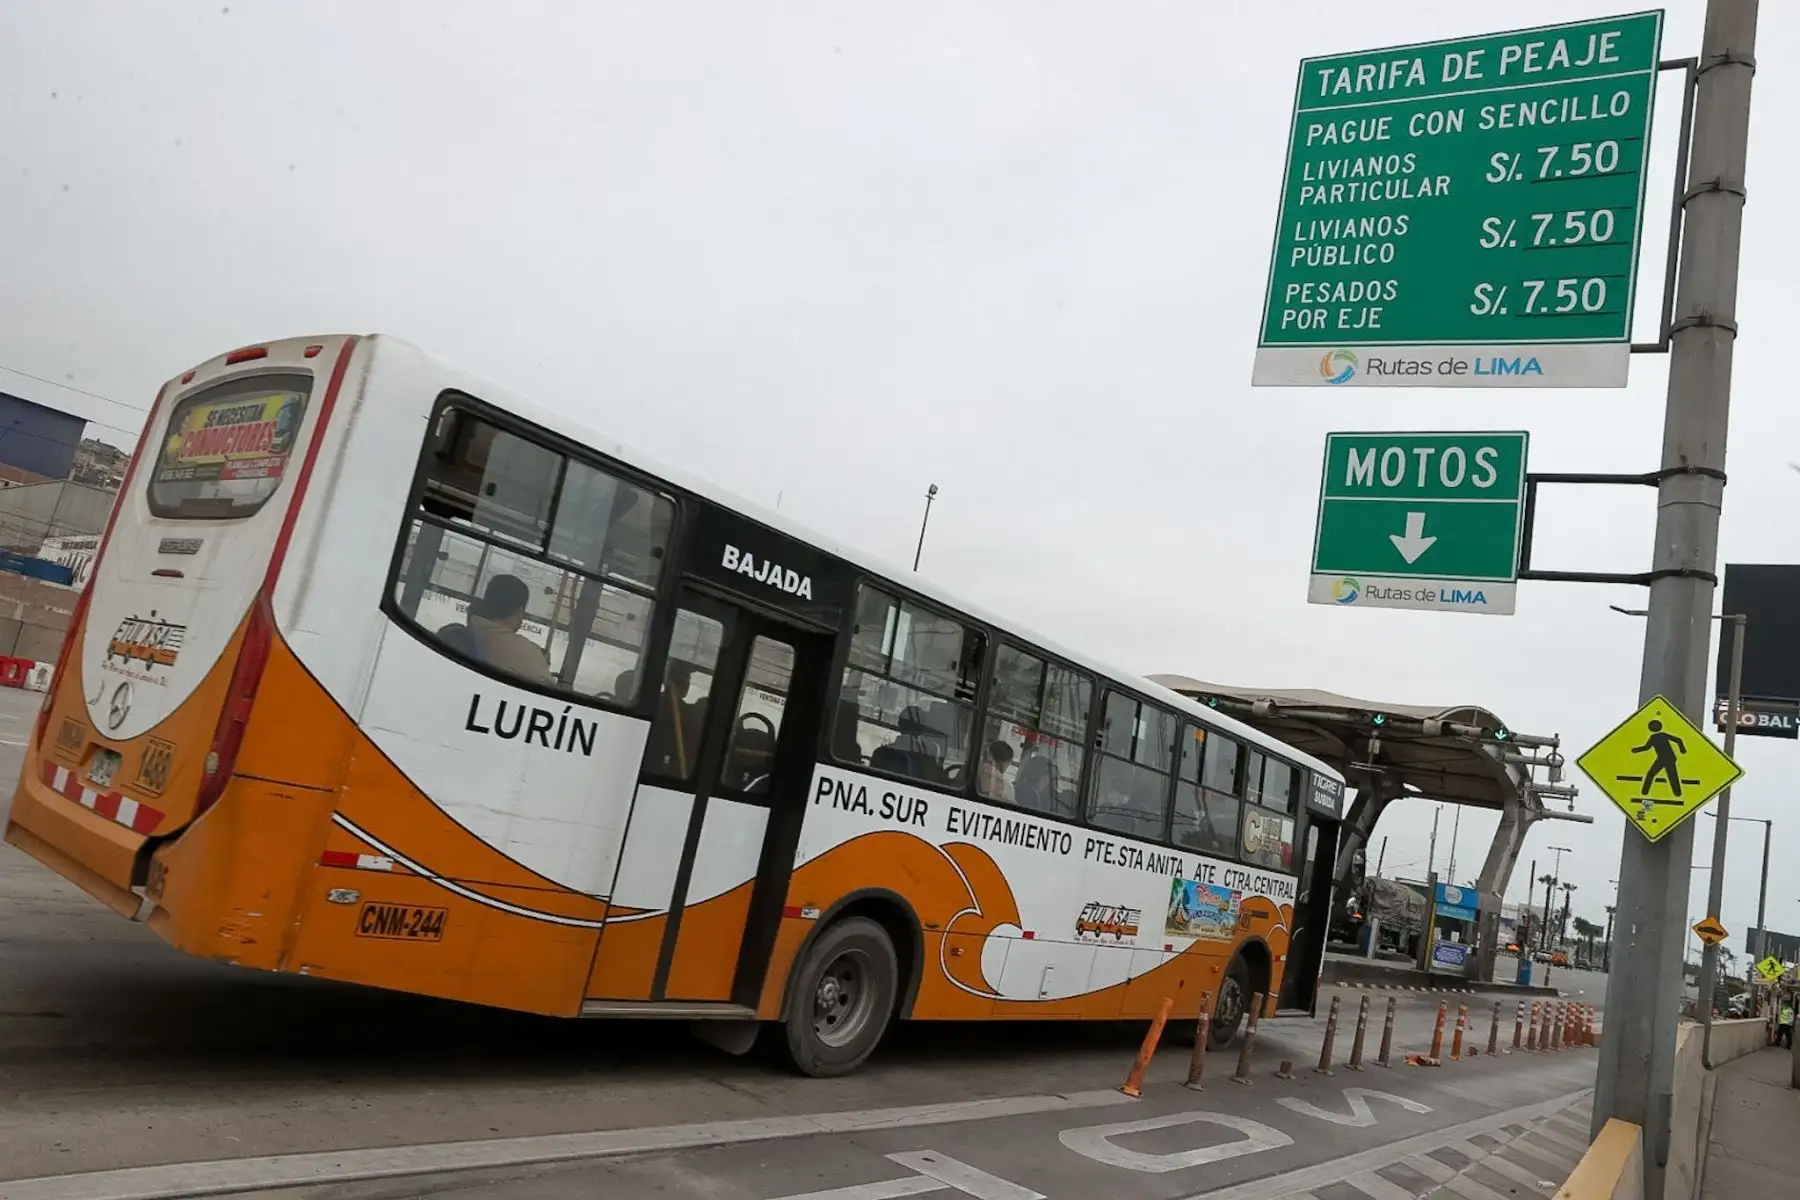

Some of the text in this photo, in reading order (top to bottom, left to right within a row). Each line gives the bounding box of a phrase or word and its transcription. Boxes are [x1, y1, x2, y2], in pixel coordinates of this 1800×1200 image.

[1318, 31, 1623, 97] TARIFA DE PEAJE
[1306, 90, 1632, 147] PAGUE CON SENCILLO
[1303, 139, 1620, 185] LIVIANOS S/. 7.50
[1299, 175, 1452, 206] PARTICULAR
[1294, 209, 1615, 249] LIVIANOS S/. 7.50
[1290, 242, 1395, 268] PÚBLICO
[1284, 277, 1607, 316] PESADOS S/. 7.50
[1280, 307, 1384, 330] POR EJE
[1366, 357, 1544, 376] Rutas de LIMA
[1345, 446, 1498, 488] MOTOS
[721, 543, 813, 600] BAJADA
[1365, 585, 1488, 604] Rutas de LIMA
[465, 693, 598, 757] LURÍN
[1313, 772, 1338, 795] TIGRE
[946, 807, 1073, 855] EVITAMIENTO
[1192, 862, 1217, 884] ATE
[360, 905, 445, 938] CNM-244
